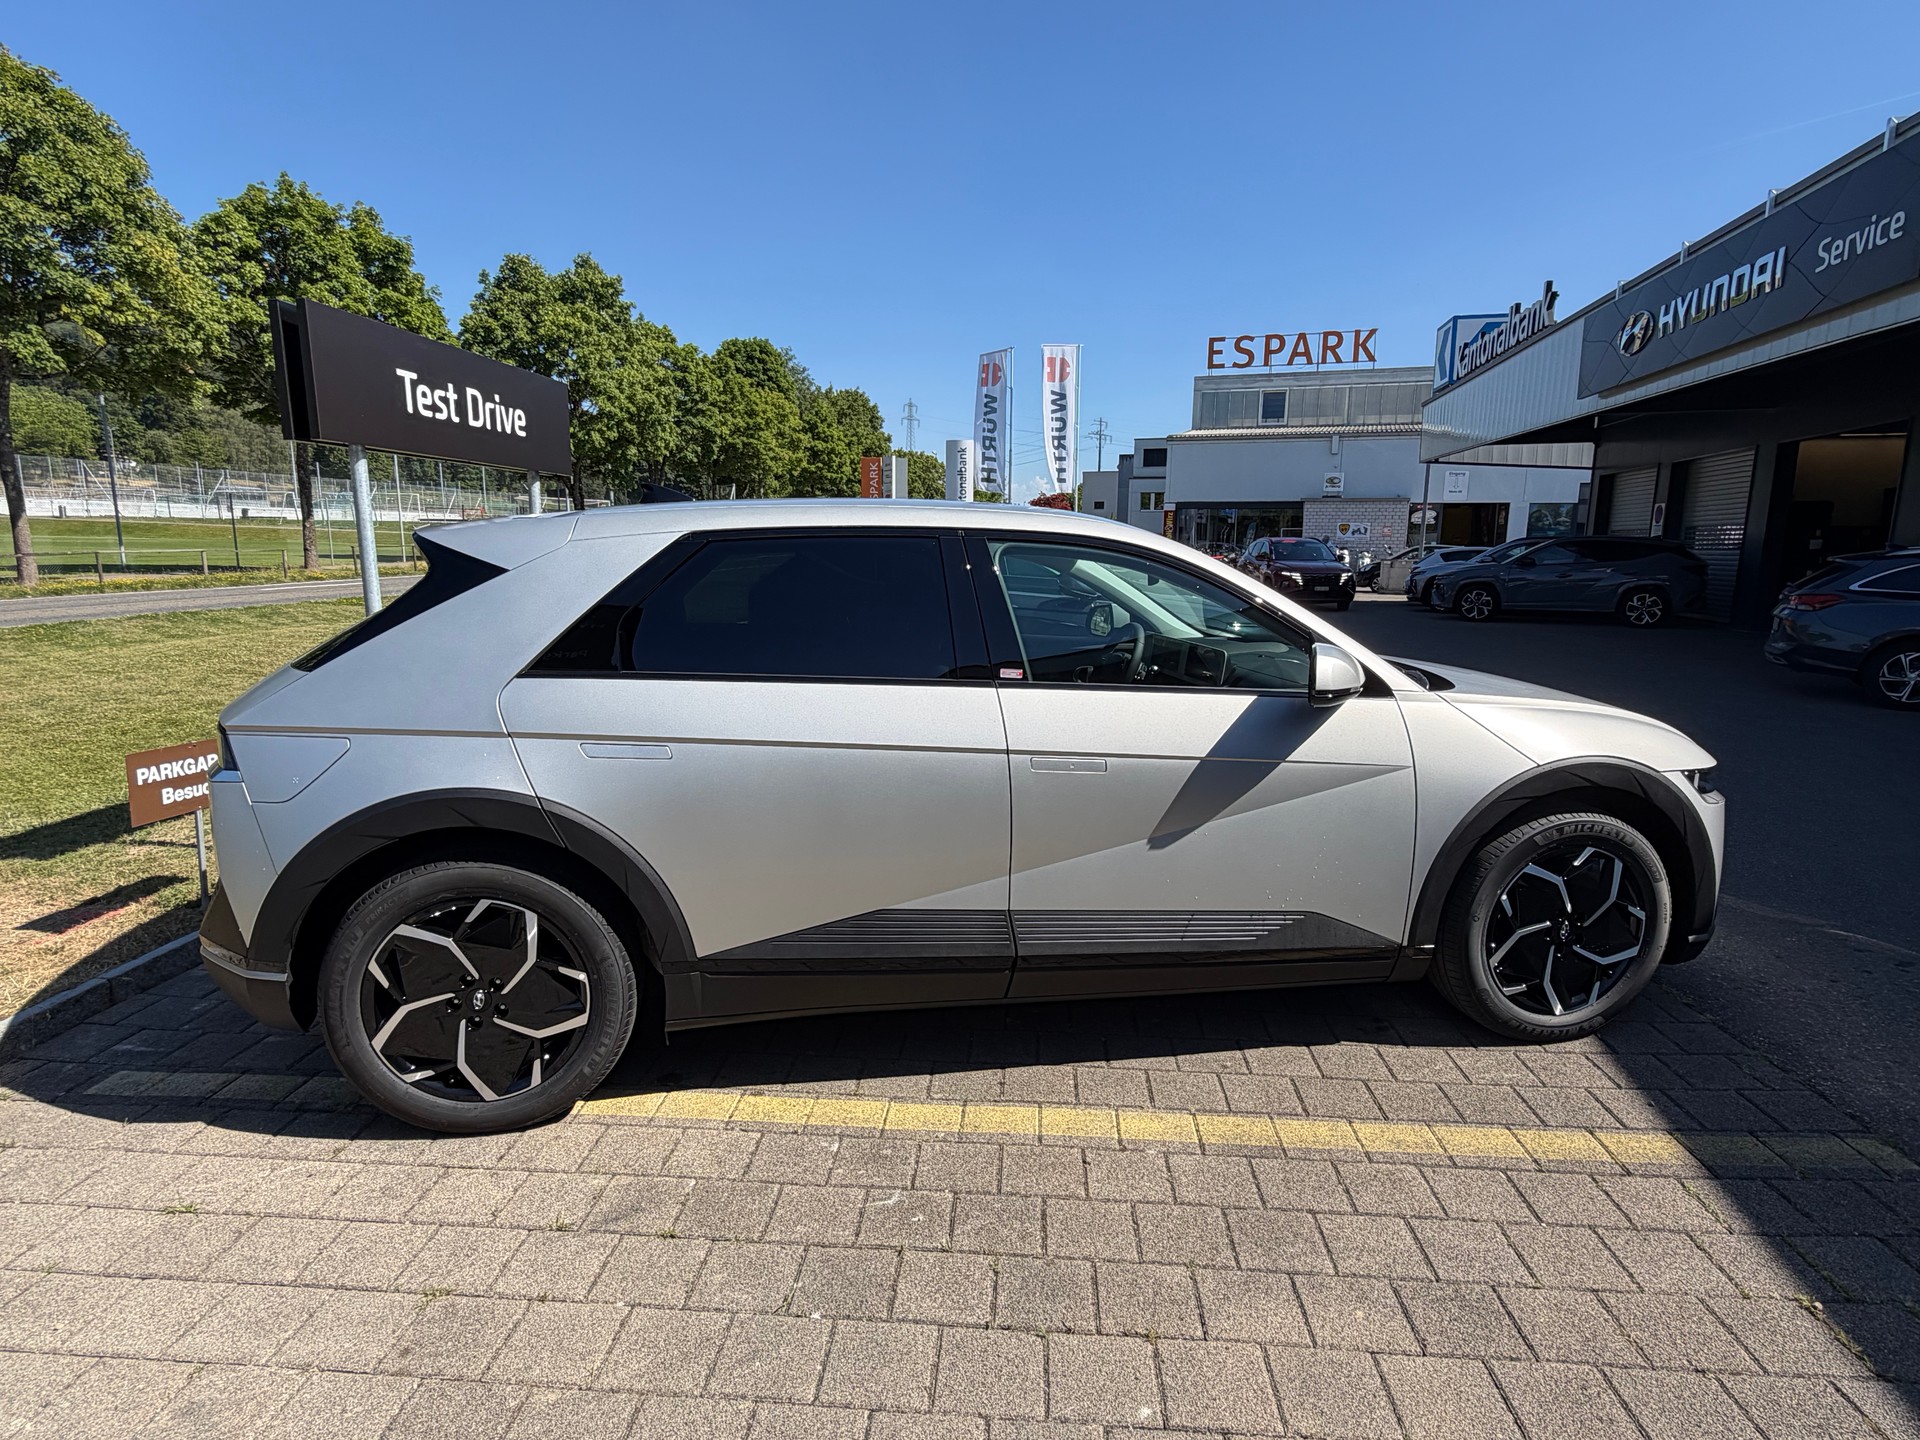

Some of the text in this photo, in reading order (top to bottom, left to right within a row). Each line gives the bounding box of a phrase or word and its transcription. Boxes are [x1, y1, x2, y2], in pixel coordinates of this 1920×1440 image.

[1658, 210, 1906, 338] HYUNDAI Service
[1208, 328, 1378, 367] ESPARK
[1453, 280, 1560, 381] Kantonalbank
[395, 367, 527, 438] Test Drive
[1562, 823, 1634, 846] MICHELIN
